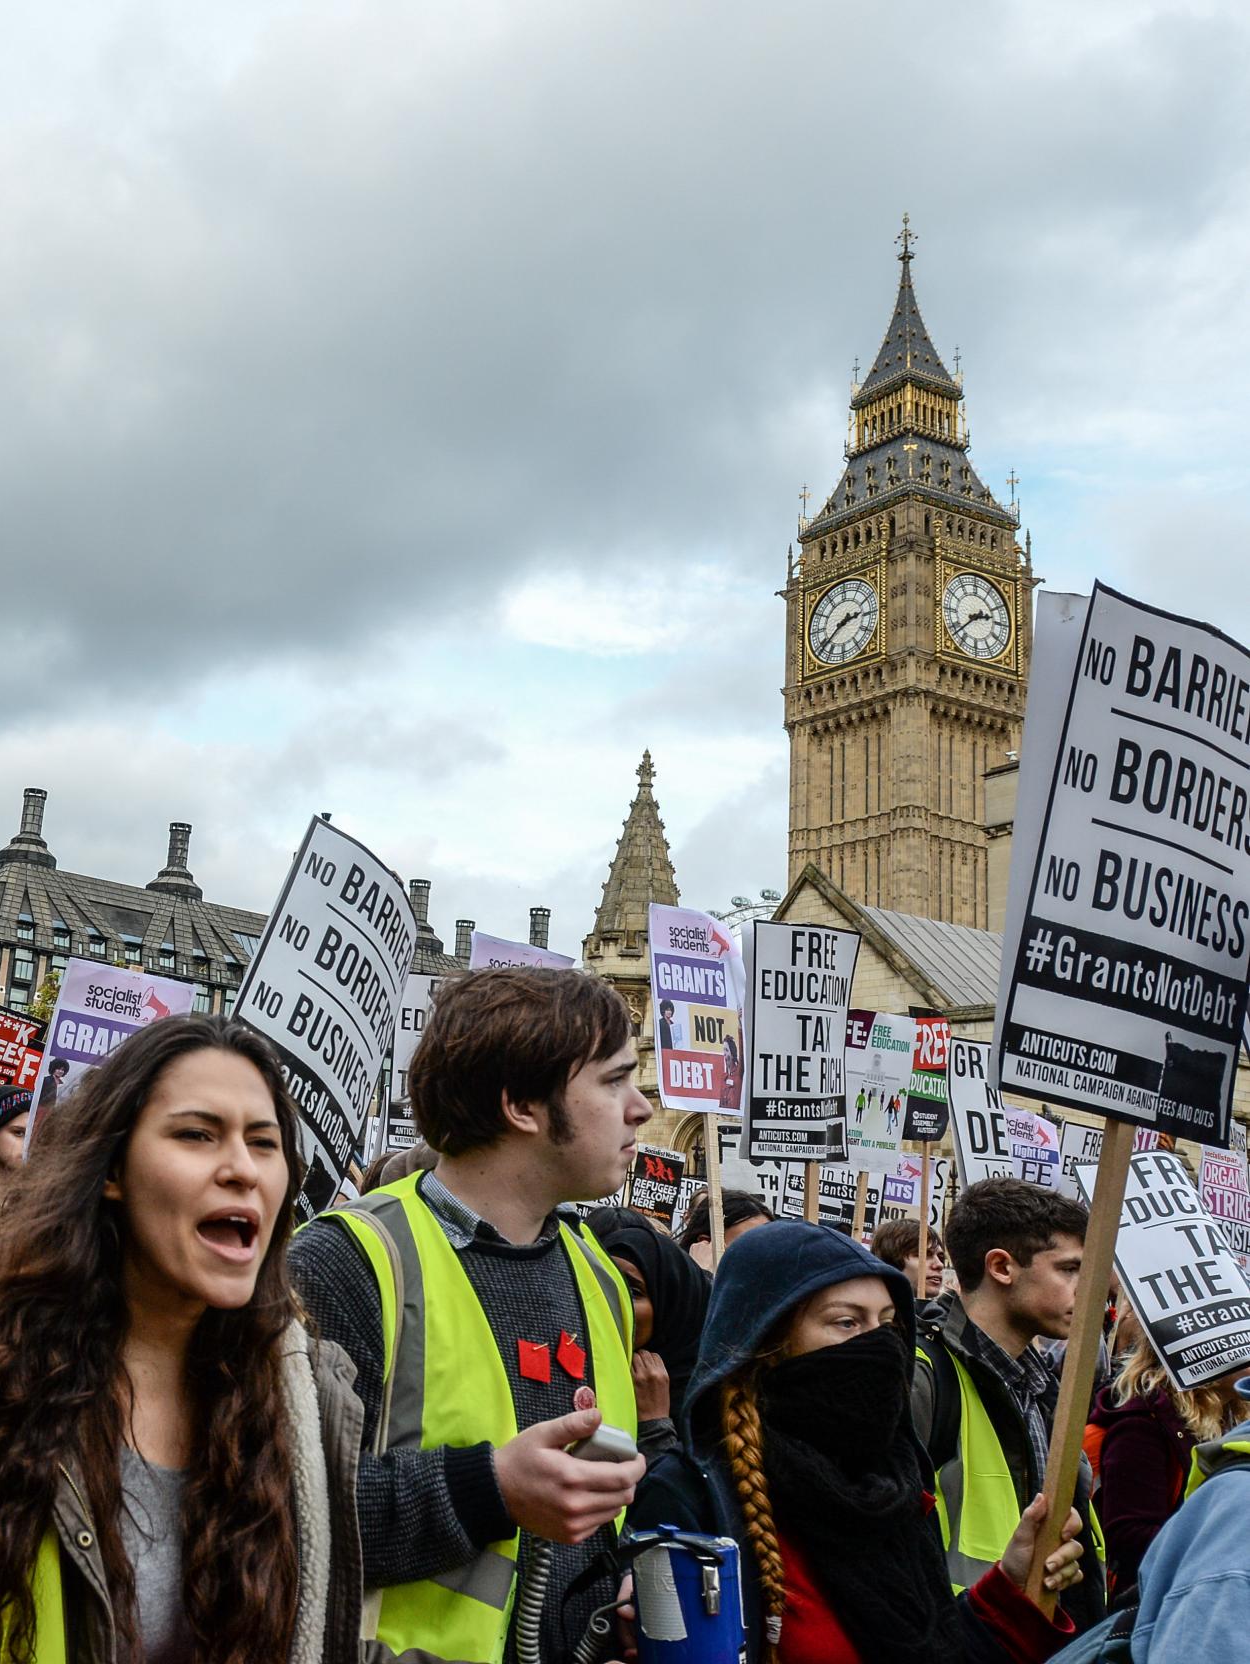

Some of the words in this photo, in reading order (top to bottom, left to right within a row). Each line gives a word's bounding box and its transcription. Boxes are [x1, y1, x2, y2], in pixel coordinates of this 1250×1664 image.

[1084, 637, 1116, 686] NO
[1063, 746, 1097, 793] NO
[304, 851, 337, 887] NO
[1044, 855, 1081, 902] NO
[1091, 848, 1250, 959] BUSINESS
[669, 926, 707, 943] socialist
[670, 936, 710, 953] students
[792, 929, 838, 972] FREE
[87, 984, 142, 1006] socialist
[278, 914, 310, 951] NO
[314, 924, 394, 1058] BORDERS
[658, 962, 726, 999] GRANTS
[761, 969, 848, 1008] EDUCATION
[1025, 928, 1237, 1030] #GrantsNotDebt
[84, 995, 142, 1018] students
[56, 1019, 131, 1057] GRAN
[694, 1014, 724, 1045] NOT
[797, 1014, 831, 1053] TAX
[871, 1036, 910, 1053] EDUCATION
[873, 1024, 892, 1039] FREE
[251, 980, 283, 1019] NO
[286, 992, 372, 1121] BUSINESS
[1020, 1031, 1117, 1075] ANTICUTS.COM
[669, 1058, 713, 1091] DEBT
[759, 1053, 811, 1094] THE
[821, 1056, 842, 1095] RICH
[1016, 1059, 1070, 1089] NATIONAL
[1073, 1074, 1125, 1102] CAMPAIGN
[1126, 1090, 1158, 1112] AGANIST
[1158, 1096, 1176, 1117] FEES
[1177, 1102, 1193, 1122] AND
[1193, 1107, 1215, 1129] CUTS
[758, 1143, 784, 1153] NATIONAL
[785, 1145, 815, 1155] CAMPAIGN
[759, 1130, 808, 1143] ANTICUTS.COM
[1014, 1144, 1037, 1159] fight
[1038, 1148, 1050, 1161] for
[631, 1196, 655, 1210] HERE
[633, 1187, 674, 1205] WELCOME
[634, 1178, 678, 1196] REFUGEES
[1138, 1260, 1233, 1311] THE
[1188, 1356, 1229, 1377] NATIONAL
